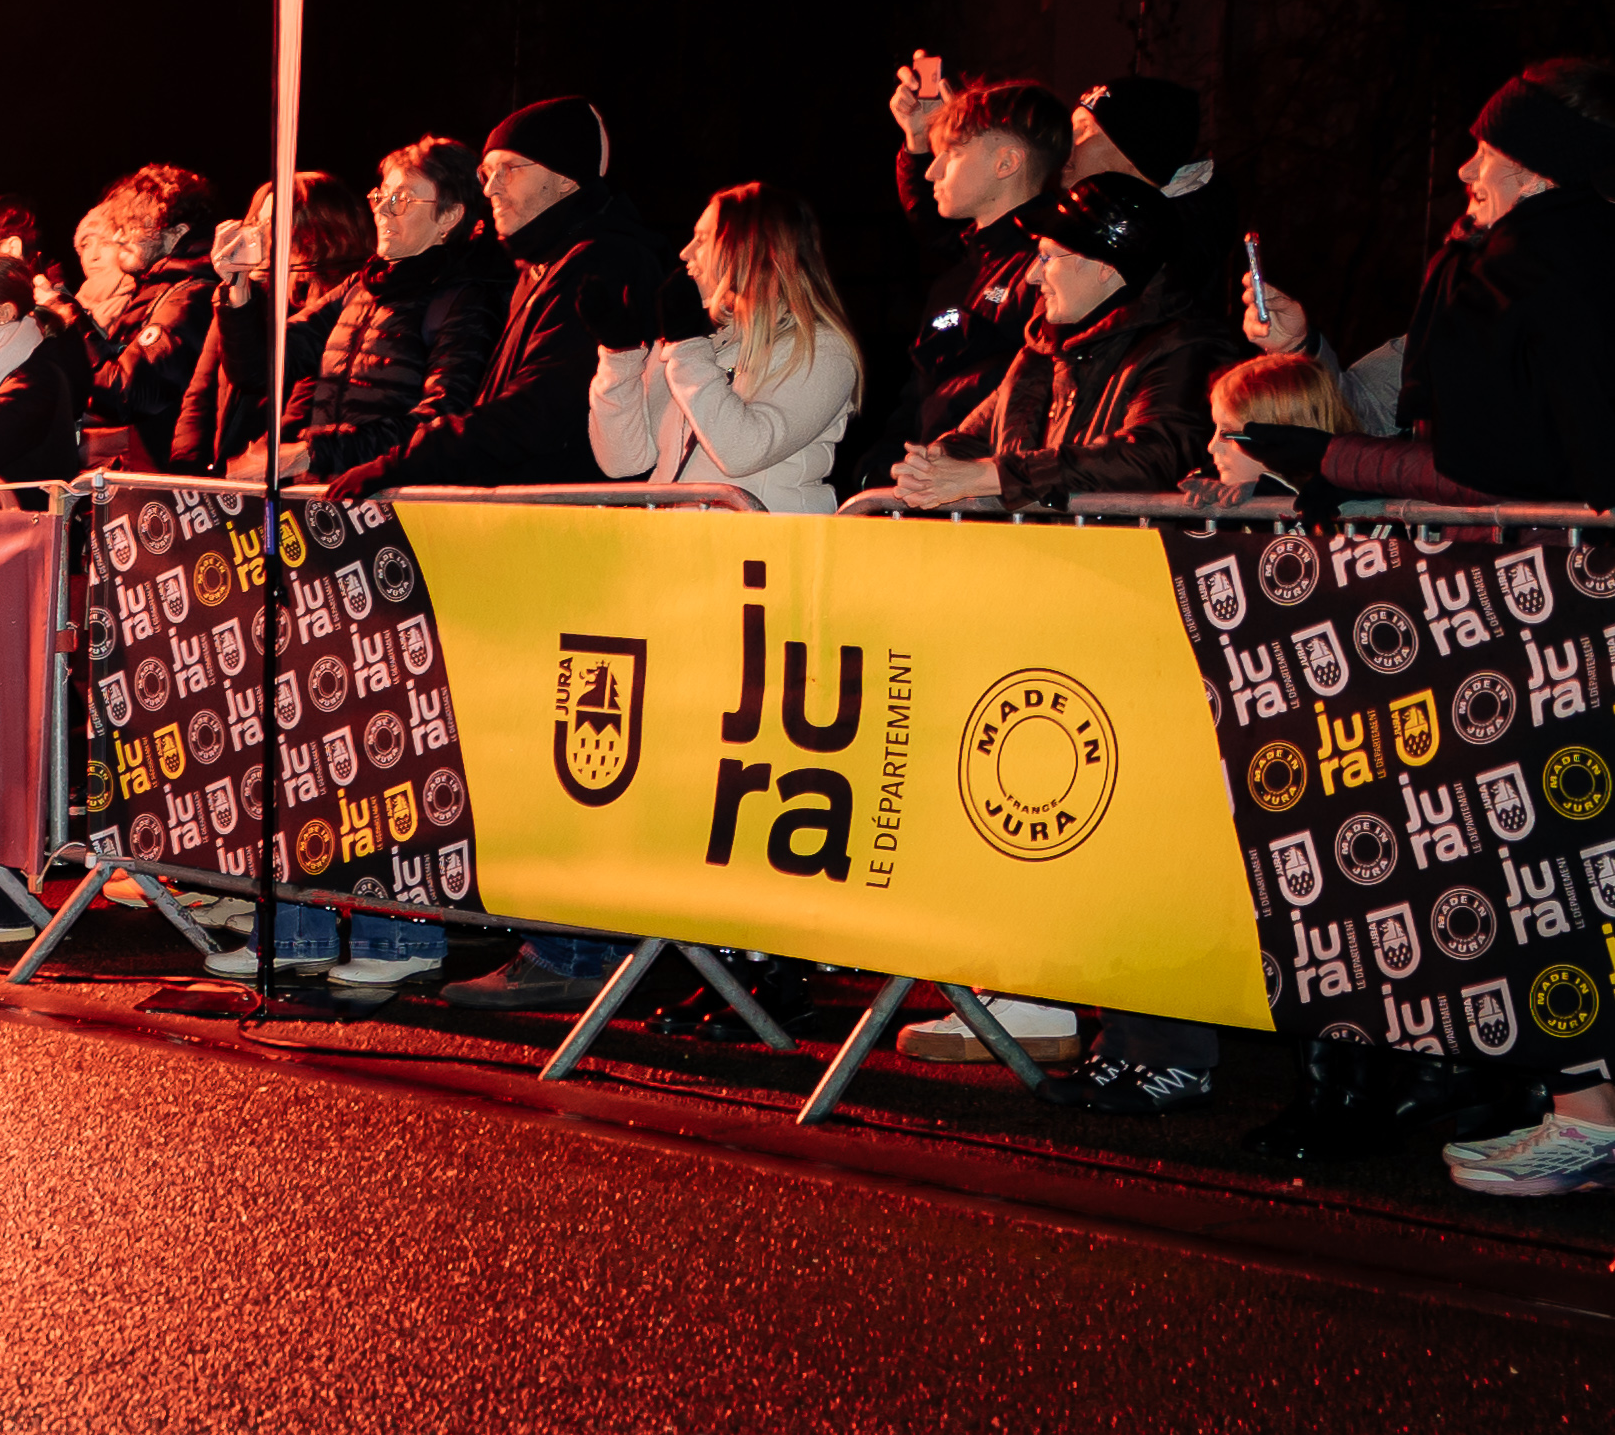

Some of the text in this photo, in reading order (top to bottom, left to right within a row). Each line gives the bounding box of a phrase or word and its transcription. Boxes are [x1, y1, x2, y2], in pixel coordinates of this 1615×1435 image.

[226, 520, 260, 565] ju
[1331, 541, 1388, 588] ra
[114, 575, 147, 620] ju
[289, 571, 324, 616] ju
[1416, 559, 1470, 621] ju
[122, 611, 155, 647] ra
[168, 627, 201, 672] ju
[297, 608, 334, 645] ra
[350, 623, 384, 670] ju
[1429, 610, 1491, 657] ra
[721, 560, 863, 753] ju
[1218, 633, 1273, 692] ju
[1520, 628, 1578, 690] ju
[175, 664, 209, 699] ra
[224, 679, 255, 724] ju
[354, 662, 391, 699] ra
[407, 679, 440, 727] ju
[555, 656, 574, 717] JURA
[1529, 678, 1586, 728] ra
[976, 688, 1102, 766] MADE IN
[1233, 681, 1288, 727] ra
[113, 730, 143, 773] ju
[411, 718, 449, 756] ra
[1314, 700, 1364, 760] ju
[277, 733, 311, 779] ju
[865, 648, 912, 889] LE DÉPARTEMENT
[1319, 749, 1374, 796] ra
[119, 766, 152, 800] ra
[163, 783, 195, 828] ju
[284, 773, 319, 808] ra
[1005, 793, 1060, 816] FRANCE
[1398, 771, 1453, 834] ju
[337, 788, 370, 835] ju
[705, 757, 854, 883] ra
[984, 797, 1078, 842] JURA
[169, 821, 202, 855] ra
[341, 827, 375, 863] ra
[1410, 823, 1469, 870] ra
[1498, 845, 1555, 908] ju
[1290, 908, 1341, 968] ju
[1510, 900, 1570, 945] ra
[1296, 961, 1352, 1004] ra
[1381, 983, 1434, 1043] ju
